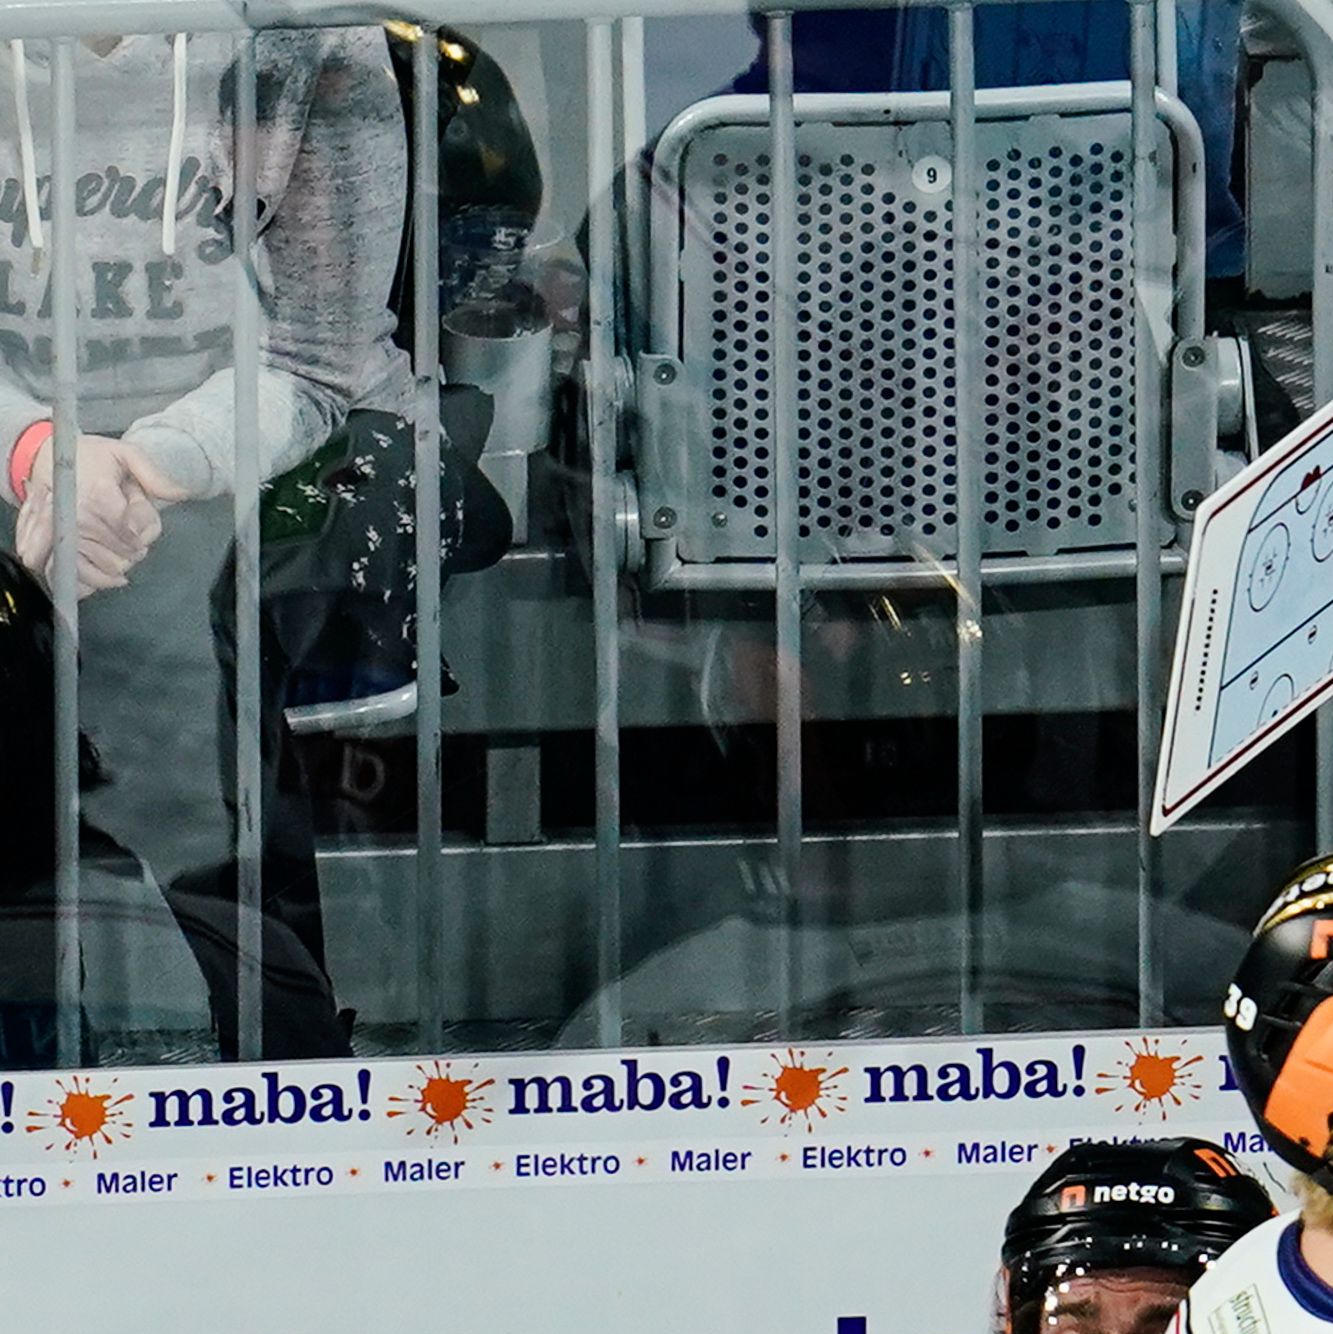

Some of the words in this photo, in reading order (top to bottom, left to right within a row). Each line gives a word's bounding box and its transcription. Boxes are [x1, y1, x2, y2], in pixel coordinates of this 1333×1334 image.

[1224, 983, 1258, 1031] 39
[148, 1068, 373, 1128] maba!
[507, 1056, 732, 1116] maba!
[863, 1044, 1087, 1104] maba!
[97, 1171, 178, 1195] Maler
[228, 1165, 334, 1190] Elektro
[383, 1158, 465, 1183] Maler
[515, 1152, 621, 1177] Elektro
[670, 1148, 752, 1172] Maler
[802, 1144, 907, 1169] Elektro
[957, 1140, 1039, 1164] Maler
[1093, 1182, 1175, 1204] netgo
